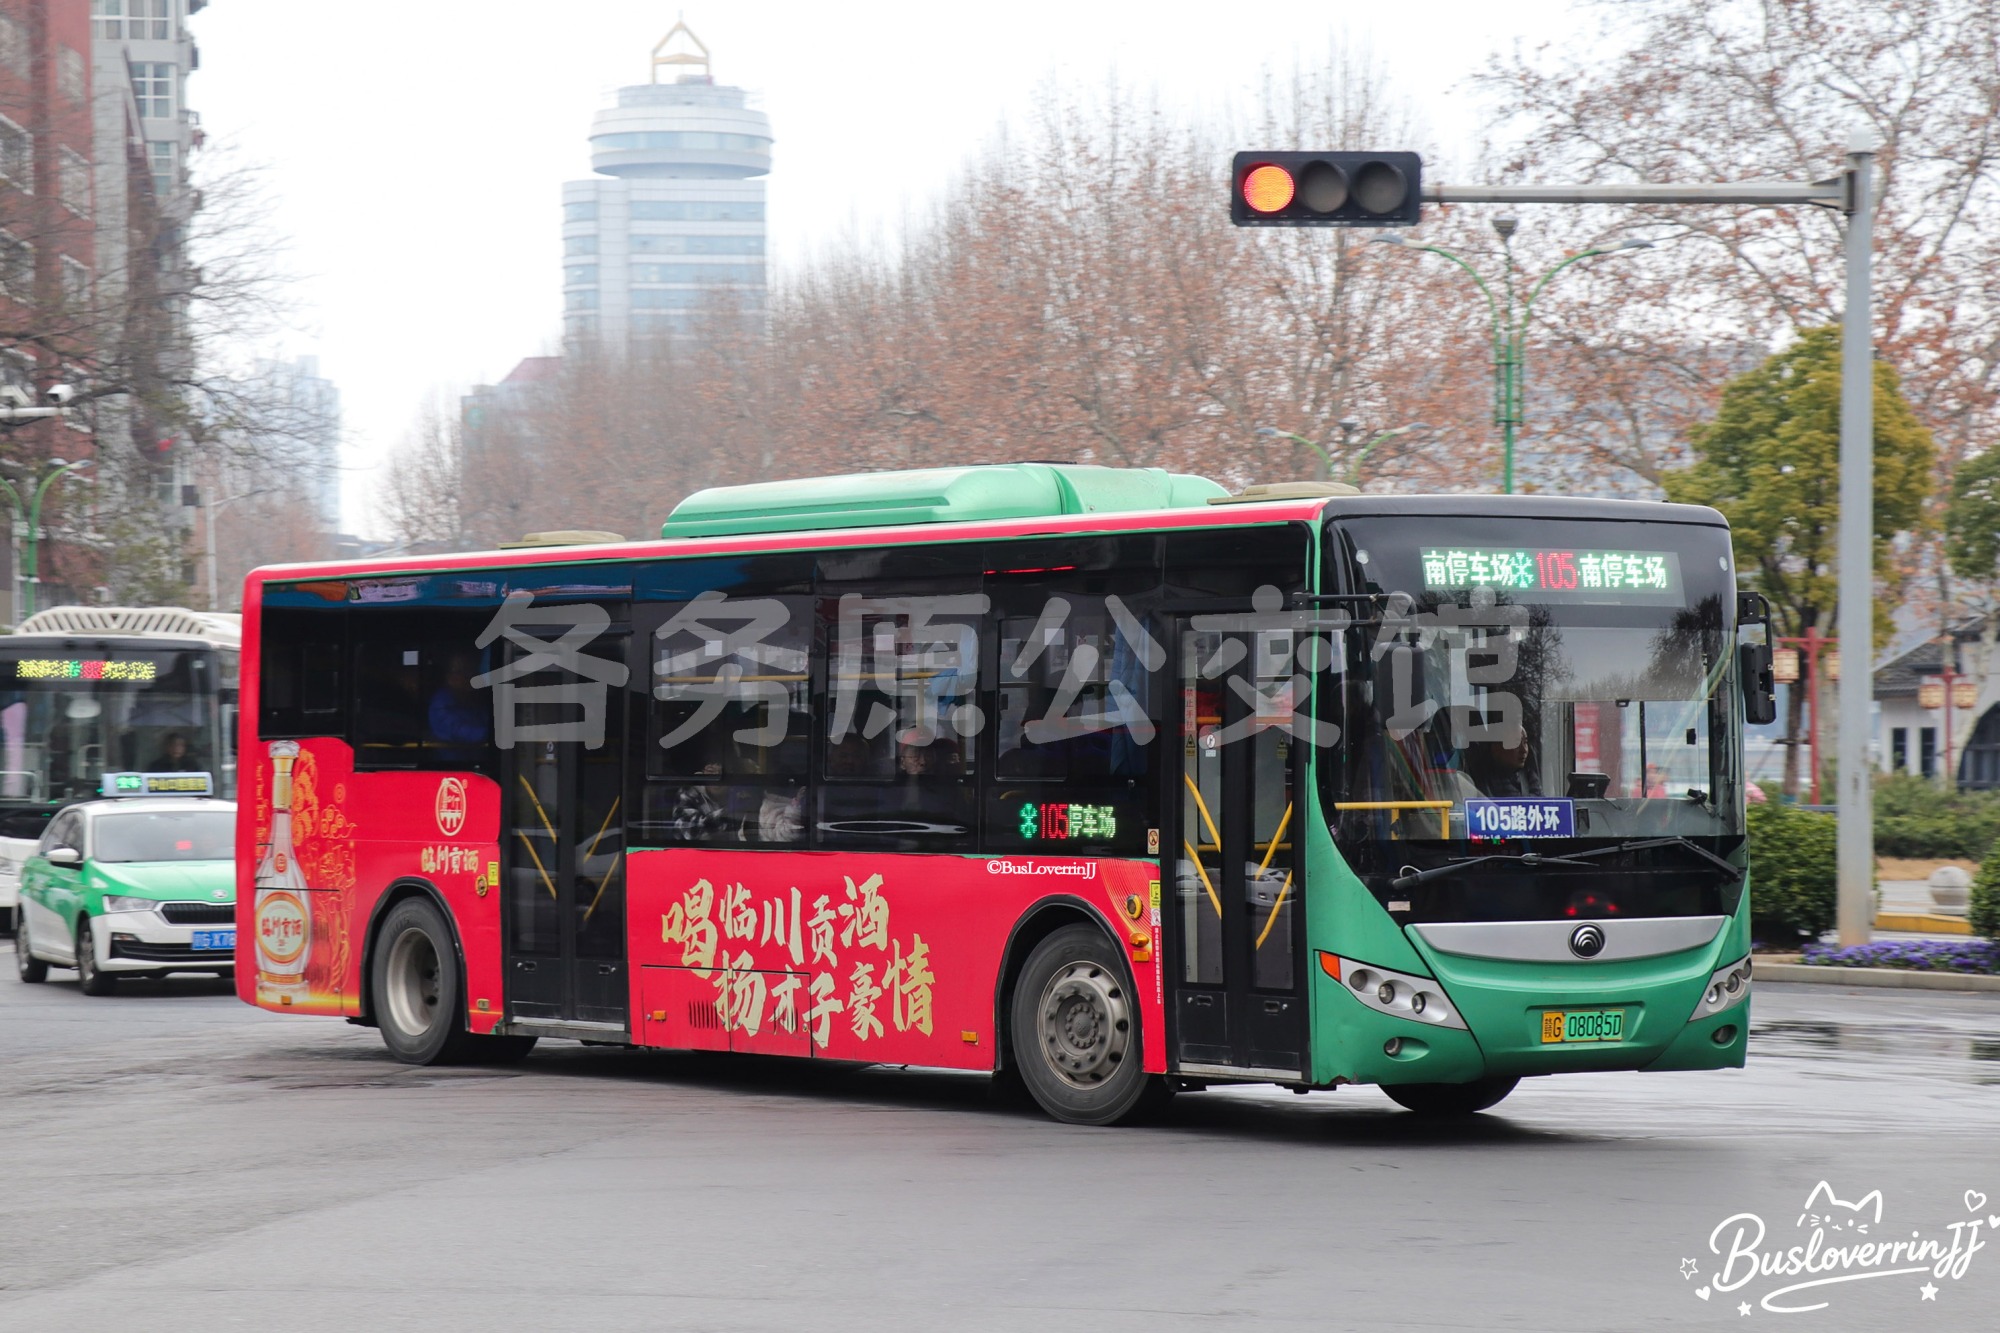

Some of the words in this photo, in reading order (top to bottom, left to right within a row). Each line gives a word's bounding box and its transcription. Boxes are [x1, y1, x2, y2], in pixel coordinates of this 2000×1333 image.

[1422, 551, 1513, 586] 南停车场
[1536, 552, 1578, 589] 105
[1580, 553, 1667, 589] 南停车场
[1040, 803, 1068, 839] 105
[1068, 804, 1116, 839] 停车场
[1475, 805, 1560, 831] 105路外环
[661, 872, 890, 980] 喝临川贡酒
[712, 932, 936, 1049] 扬才子豪情
